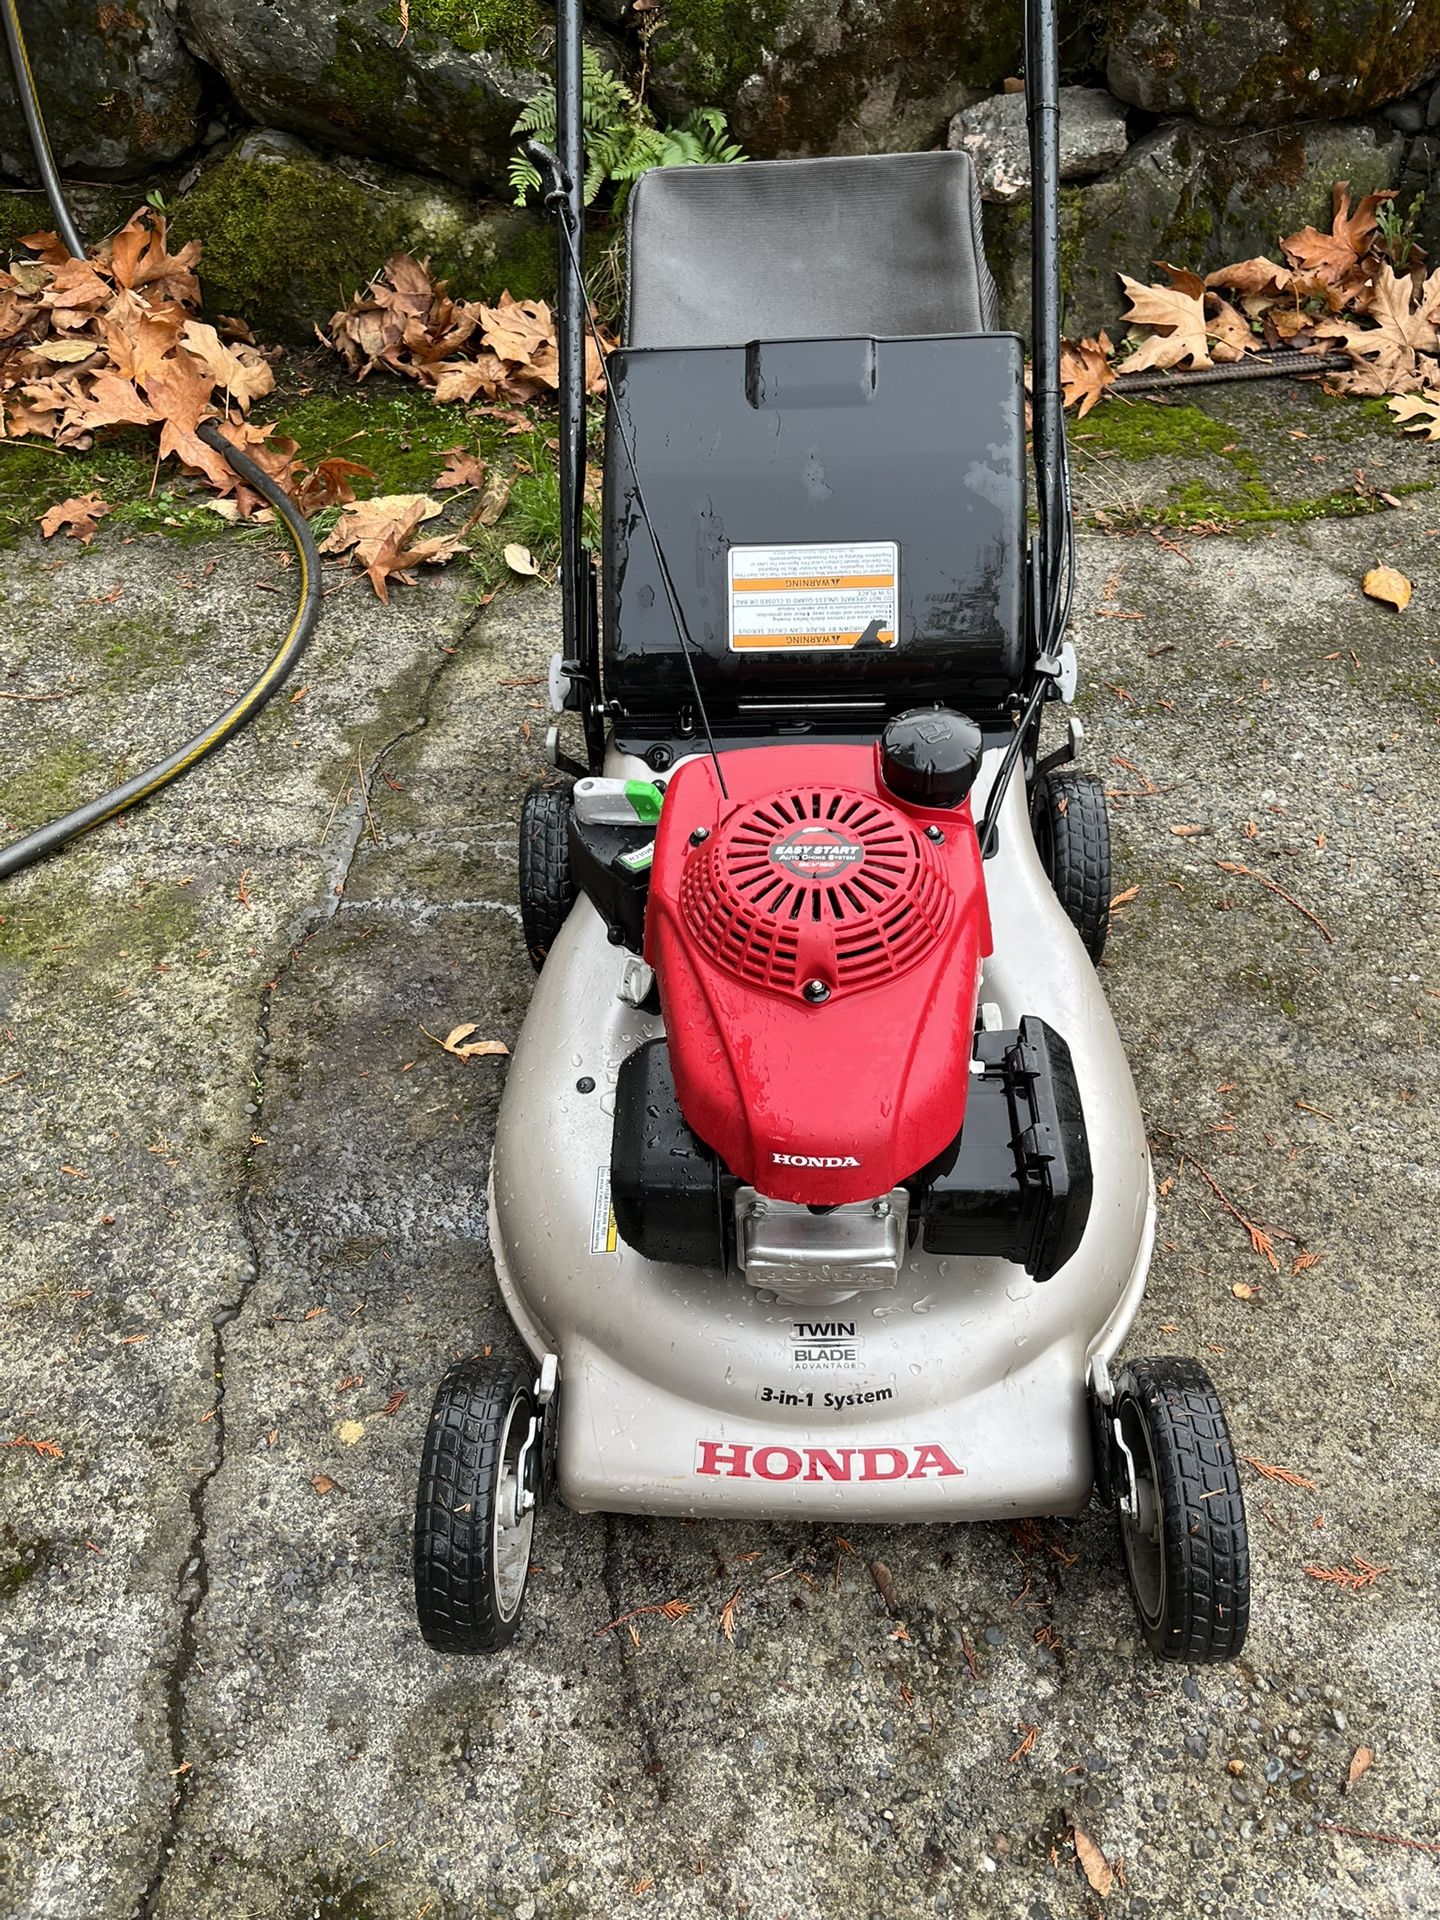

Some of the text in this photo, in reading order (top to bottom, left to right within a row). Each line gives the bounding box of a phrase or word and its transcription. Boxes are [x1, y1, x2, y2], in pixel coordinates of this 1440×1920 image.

[786, 579, 830, 587] WARNING
[786, 636, 830, 644] WARNING
[629, 847, 653, 861] MULCH
[775, 846, 859, 854] EASY START
[772, 1153, 860, 1168] HONDA
[794, 1323, 855, 1336] TWIN
[794, 1349, 856, 1361] BLADE
[761, 1387, 892, 1410] 3-in-1 System
[696, 1441, 964, 1481] HONDA
